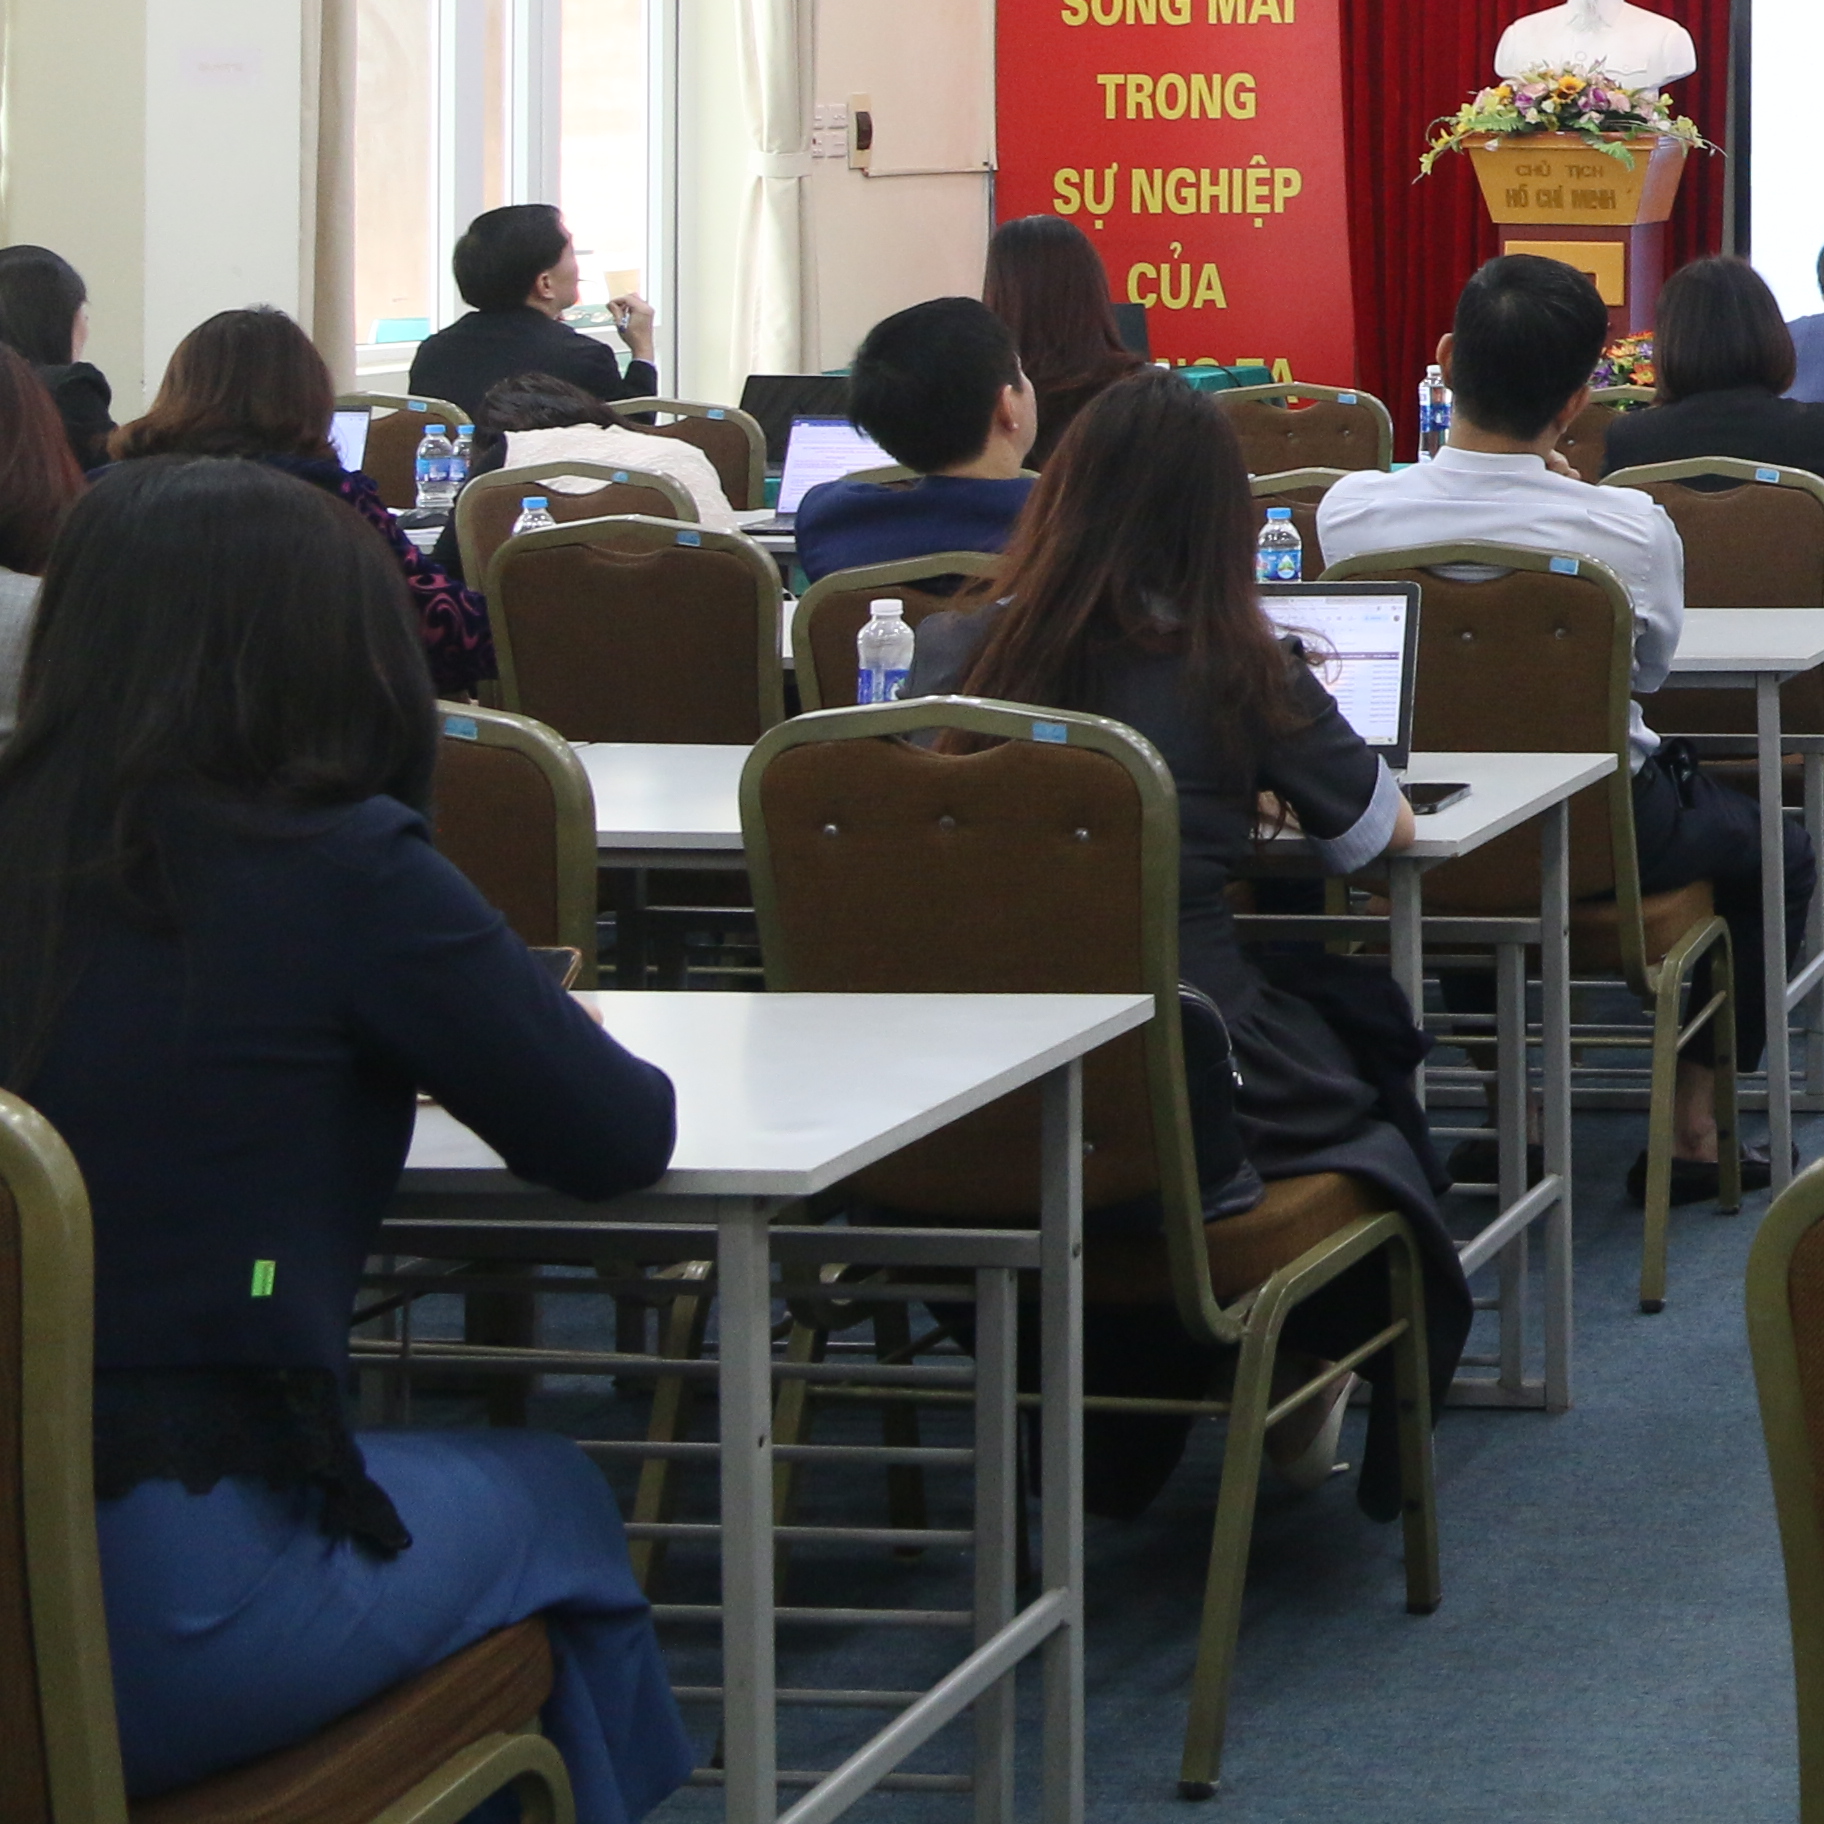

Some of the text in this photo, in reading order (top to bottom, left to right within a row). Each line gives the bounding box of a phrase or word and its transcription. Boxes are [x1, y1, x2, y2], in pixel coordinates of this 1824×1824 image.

[1097, 73, 1256, 119] TRONG
[1054, 155, 1302, 228] SỰ NGHIỆP
[1128, 243, 1226, 309] CỦA
